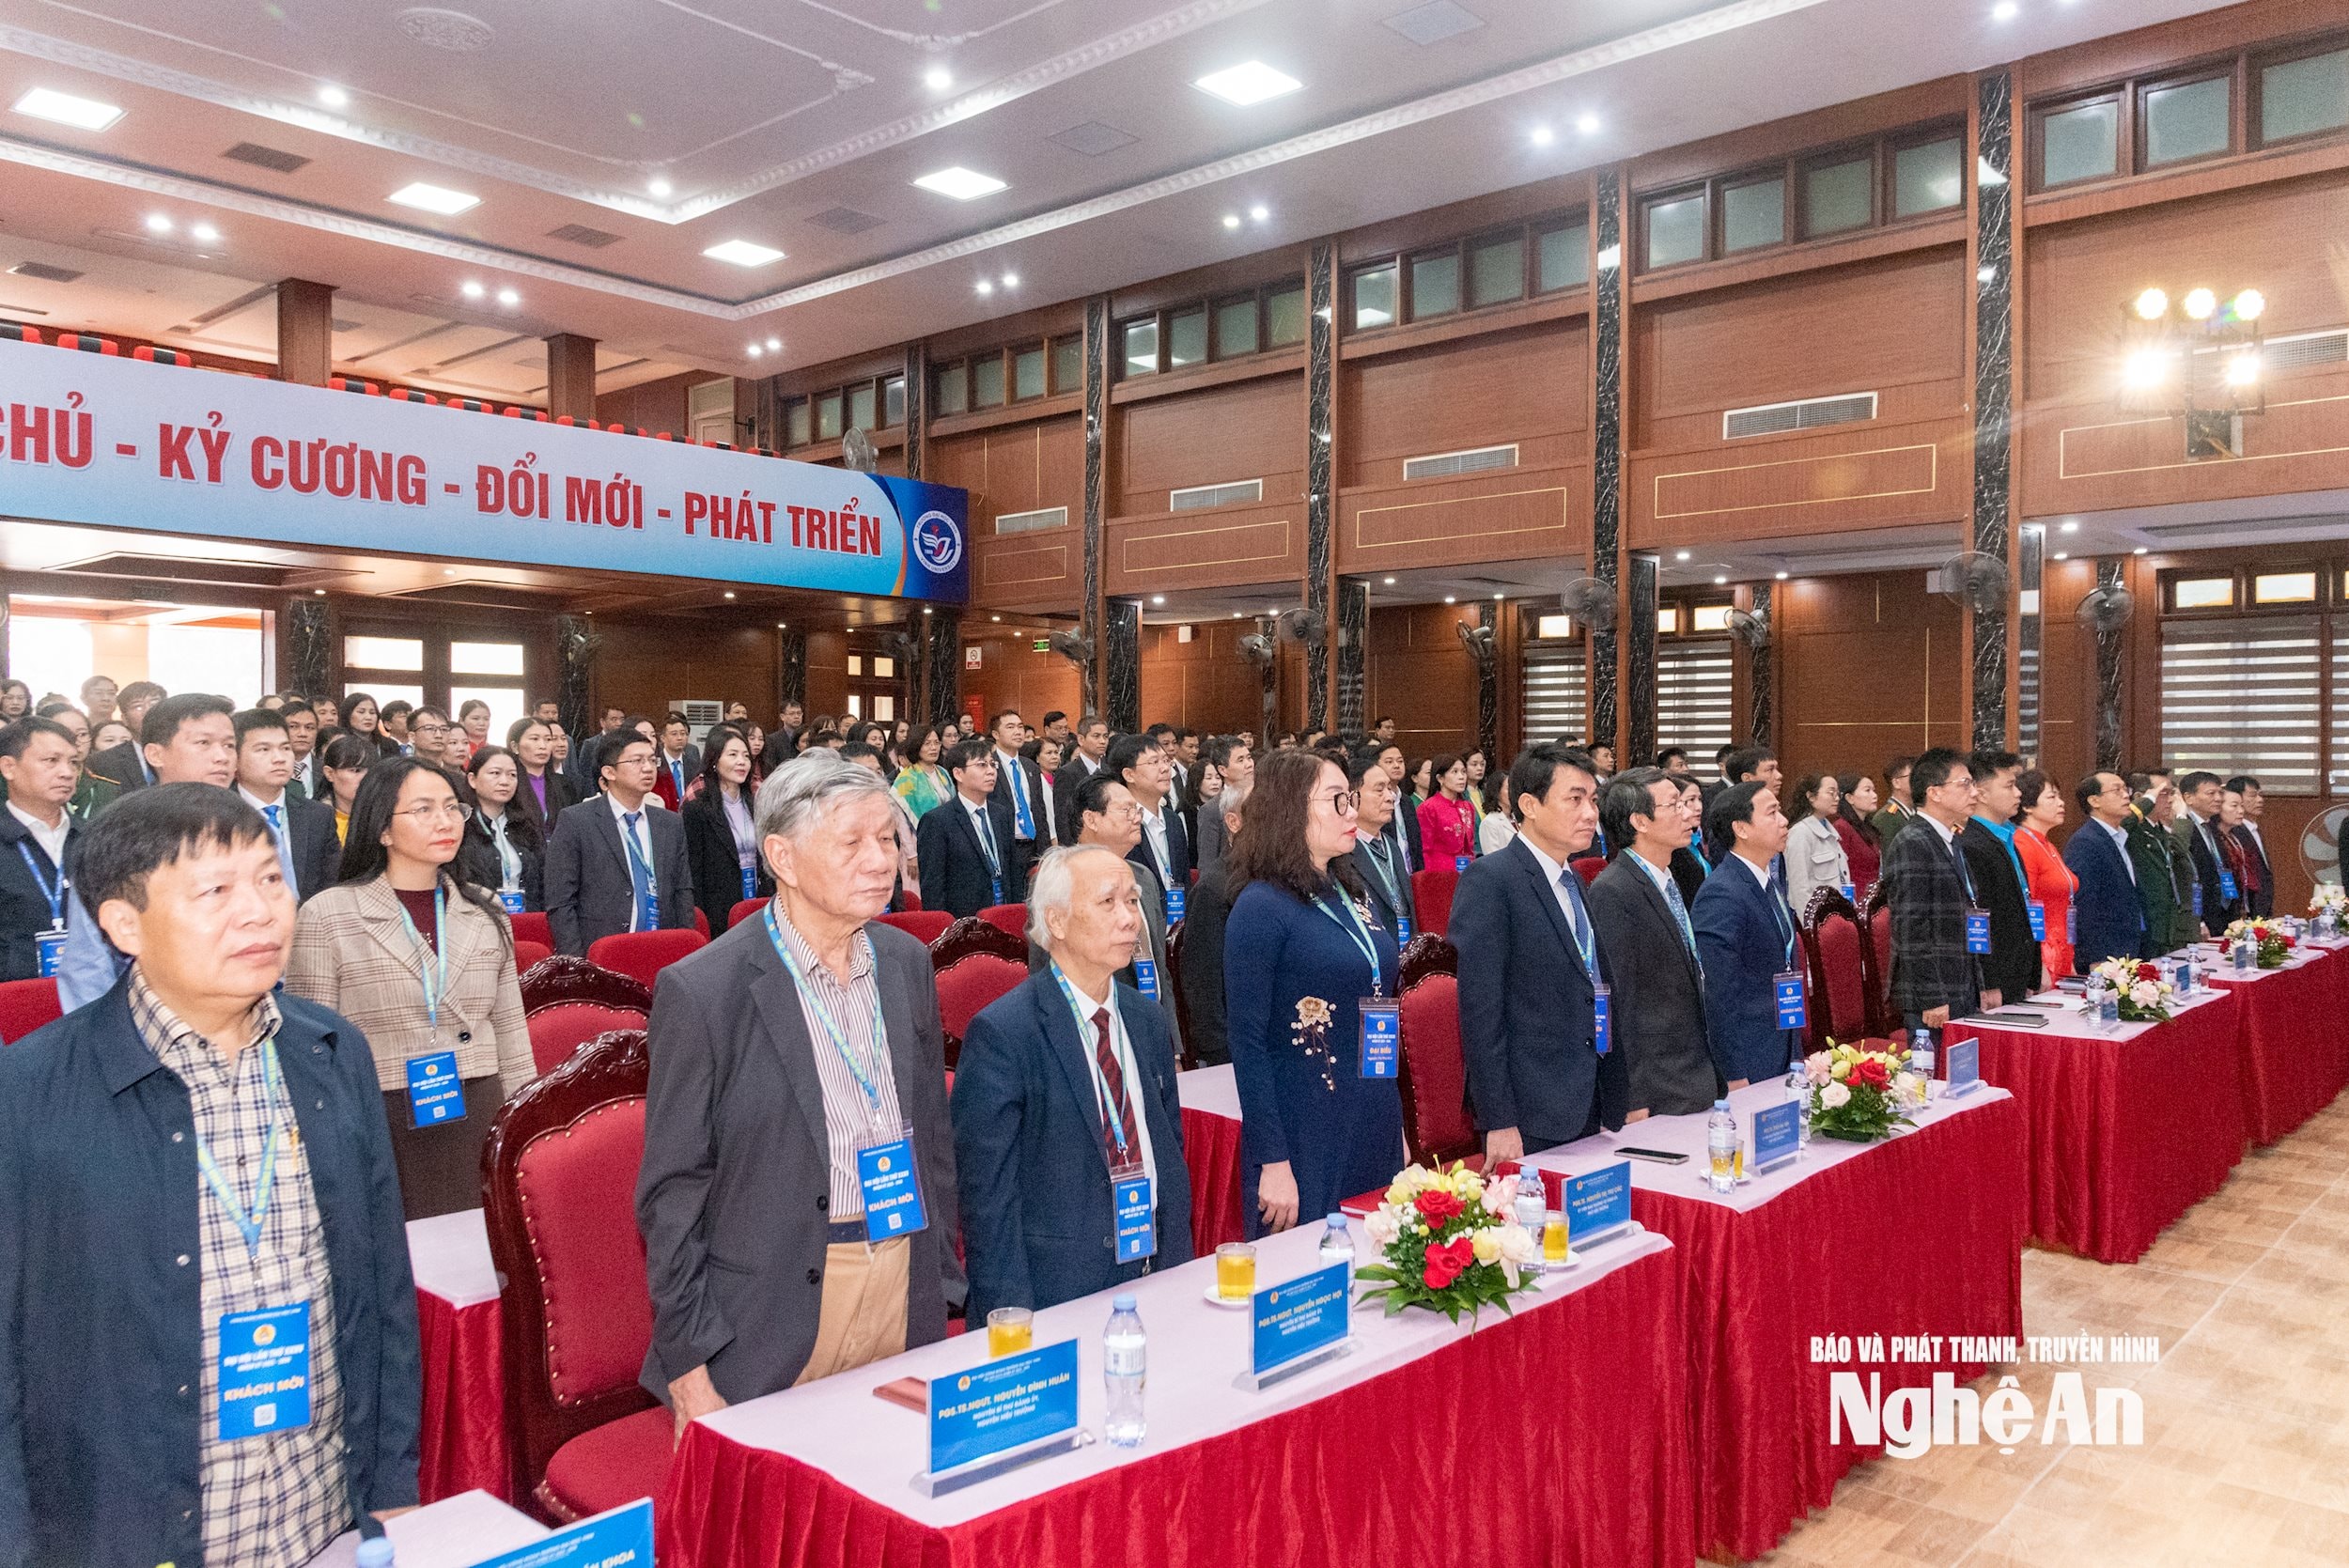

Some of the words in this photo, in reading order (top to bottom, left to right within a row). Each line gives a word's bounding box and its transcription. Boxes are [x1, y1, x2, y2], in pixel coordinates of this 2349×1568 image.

[0, 391, 93, 468] HỦ
[159, 411, 230, 483] KỶ
[251, 436, 427, 505] CƯƠNG
[476, 452, 549, 519] ĐỔI
[566, 474, 643, 529] MỚI
[685, 489, 776, 544] PHÁT
[786, 496, 880, 556] TRIỂN
[224, 1382, 275, 1402] KHÁCH
[276, 1374, 304, 1392] MỜI
[994, 1384, 1027, 1404] NGUYỄN
[1028, 1380, 1048, 1393] ĐÌNH
